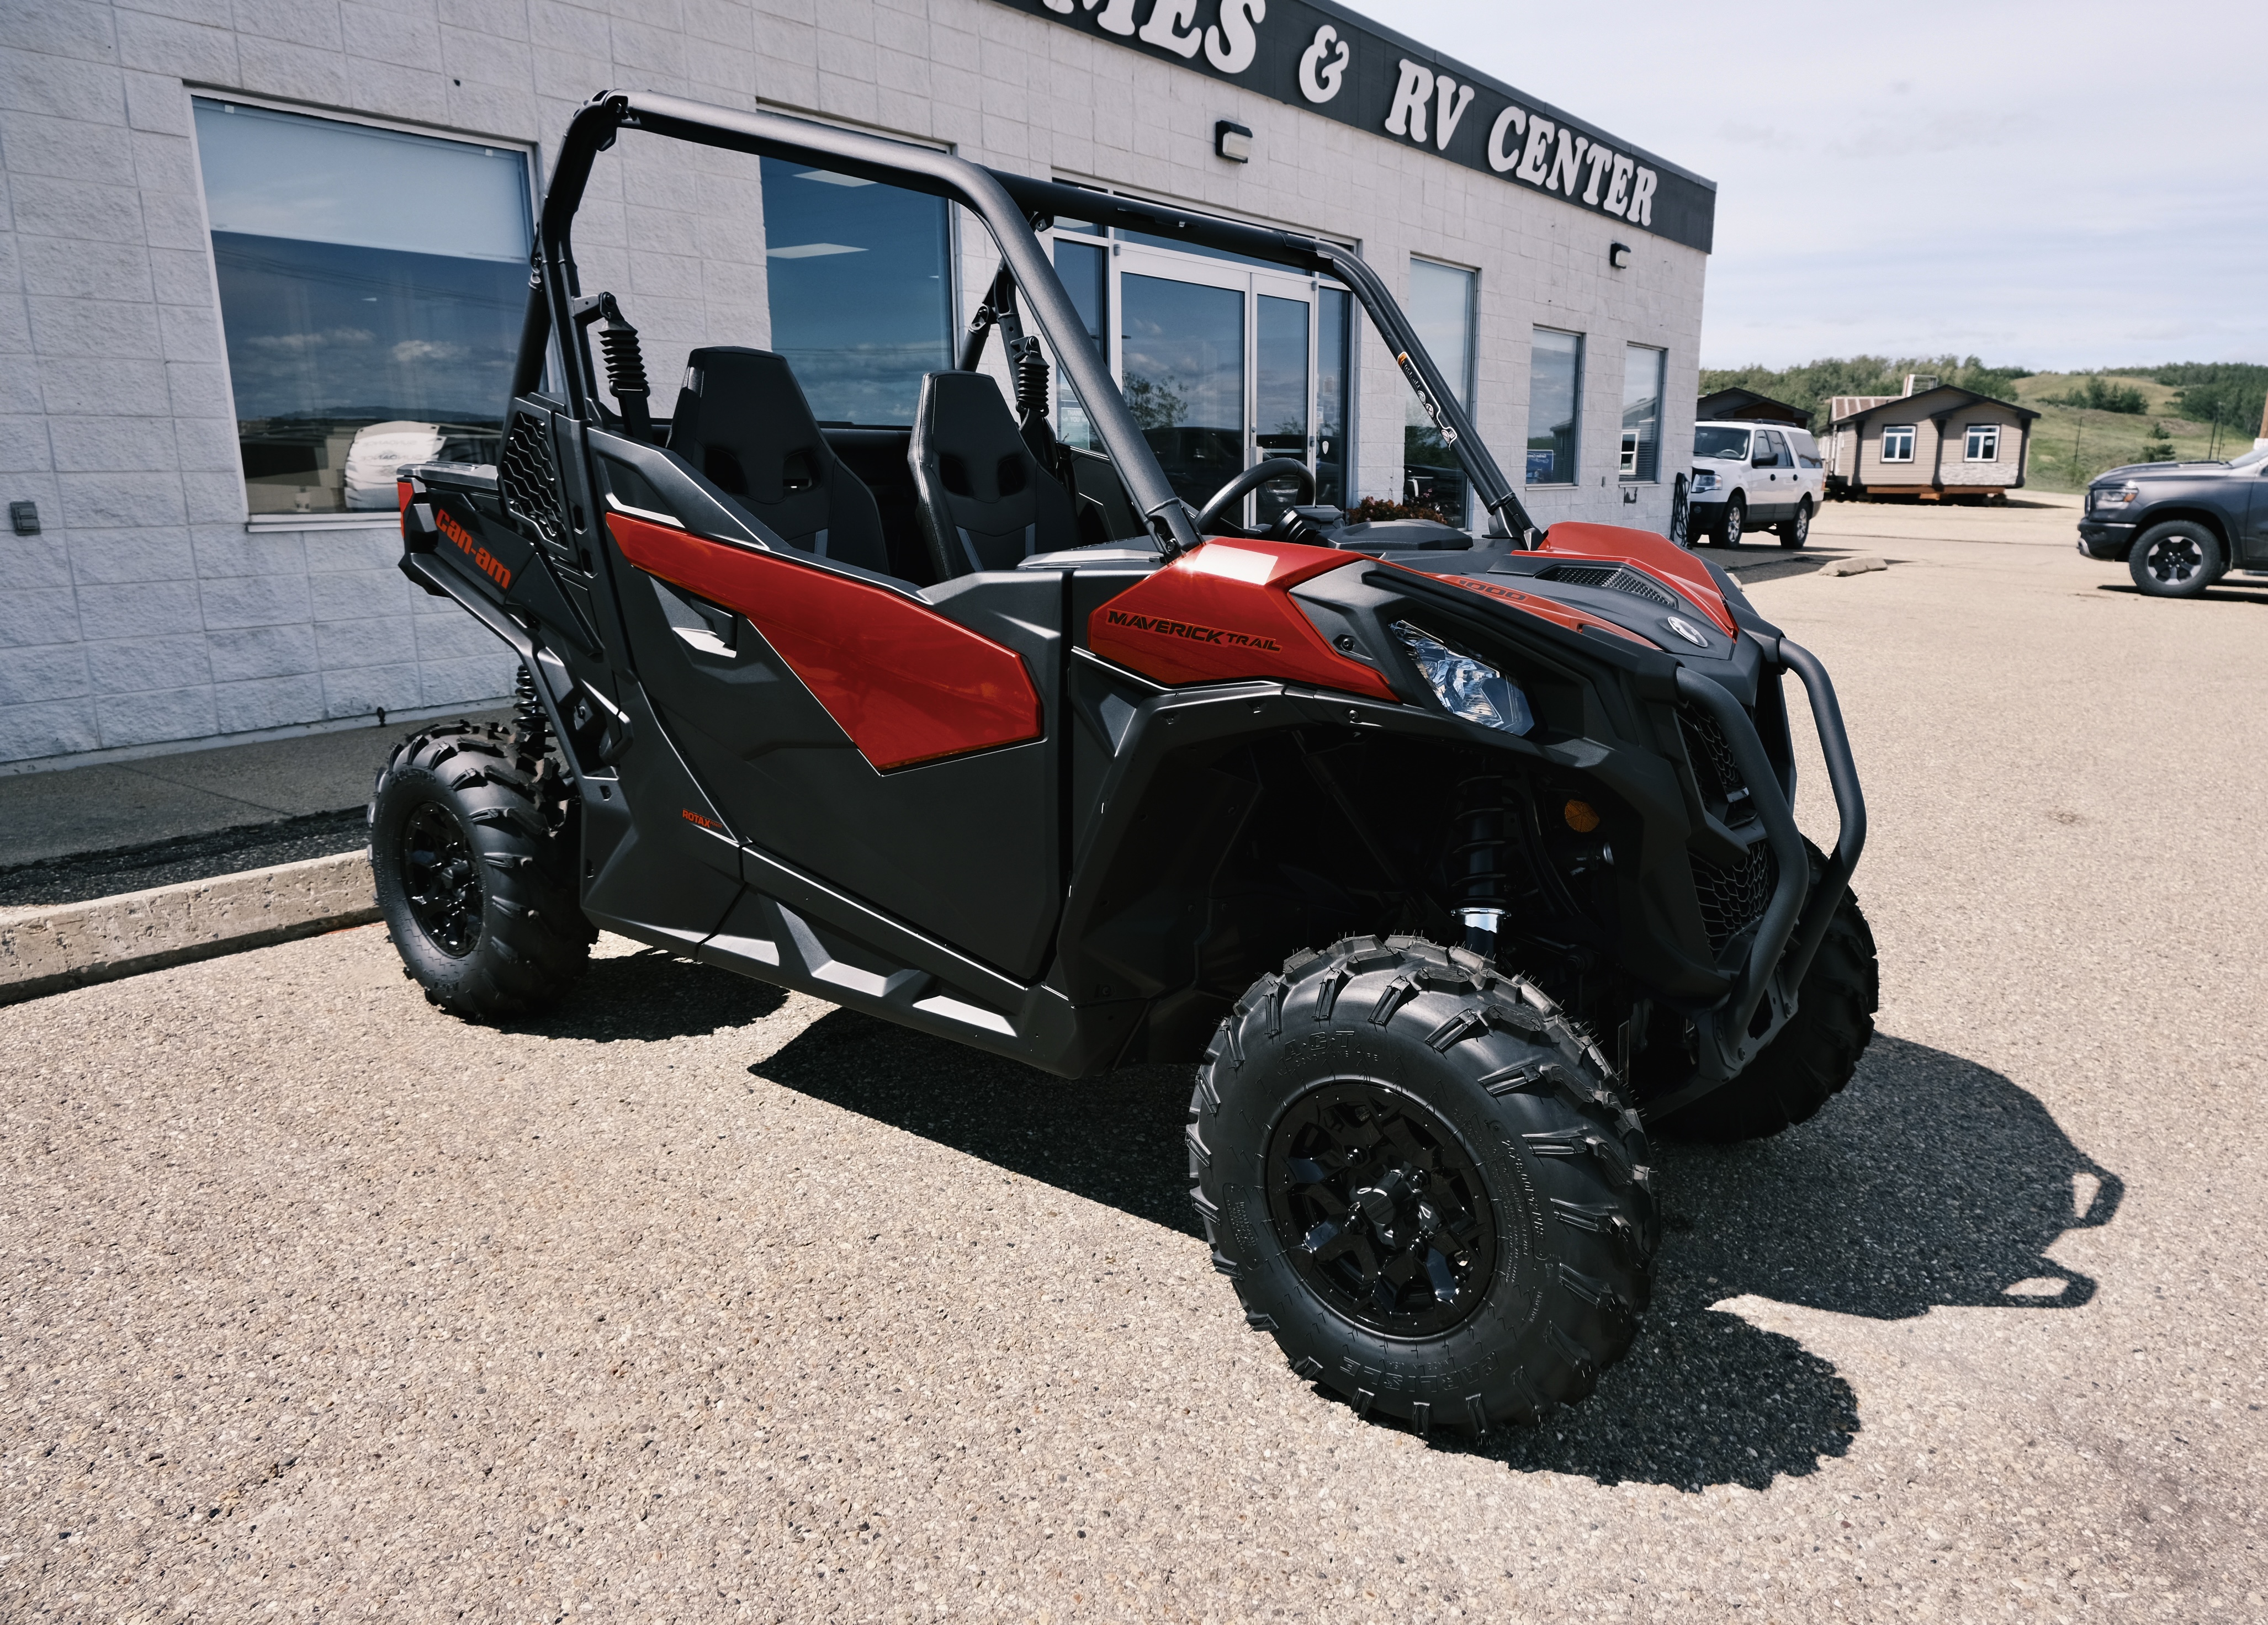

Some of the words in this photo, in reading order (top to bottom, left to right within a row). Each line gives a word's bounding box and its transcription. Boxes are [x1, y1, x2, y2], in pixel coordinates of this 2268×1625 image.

[1043, 0, 1266, 73] ES
[1299, 25, 1349, 103] &
[1385, 59, 1475, 150] RV
[1488, 106, 1657, 226] CENTER
[436, 508, 511, 589] can-am
[1459, 580, 1527, 601] 1000
[1108, 610, 1225, 645] MAVERICK
[1226, 634, 1281, 651] TRAIL
[682, 809, 710, 828] ROTAX
[1339, 1350, 1499, 1392] CARLISLE
